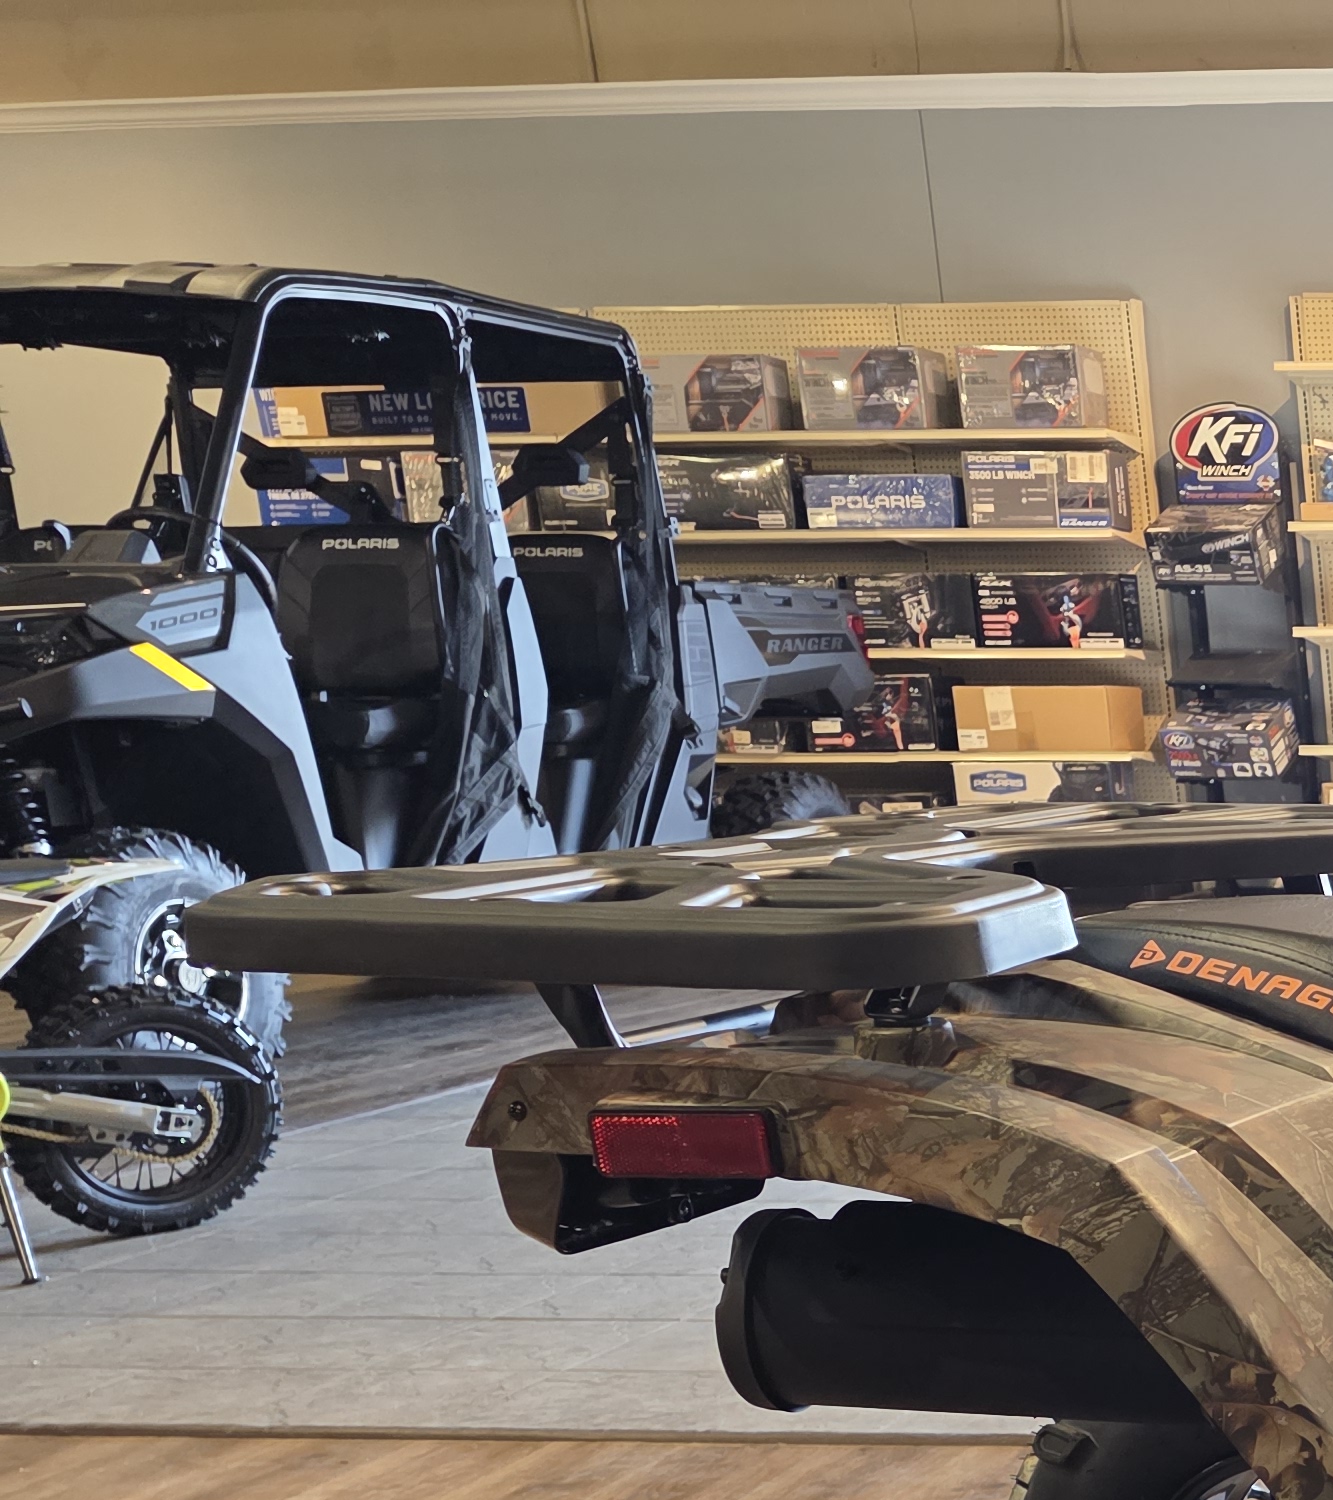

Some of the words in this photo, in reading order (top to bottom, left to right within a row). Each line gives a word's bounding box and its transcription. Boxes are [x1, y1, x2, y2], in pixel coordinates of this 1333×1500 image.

[368, 393, 409, 412] NEW
[478, 390, 521, 409] RICE
[967, 454, 1016, 463] POLARIS
[968, 470, 991, 480] 3500
[992, 470, 1004, 480] LB
[1006, 470, 1036, 480] WINCH
[1201, 464, 1252, 477] WINCH
[830, 494, 927, 509] POLARIS
[321, 537, 400, 550] POLARIS
[1214, 533, 1249, 551] WINCH
[512, 546, 584, 558] POLARIS
[150, 607, 218, 631] 1000
[766, 634, 844, 654] RANGER
[973, 779, 1024, 788] POLARIS
